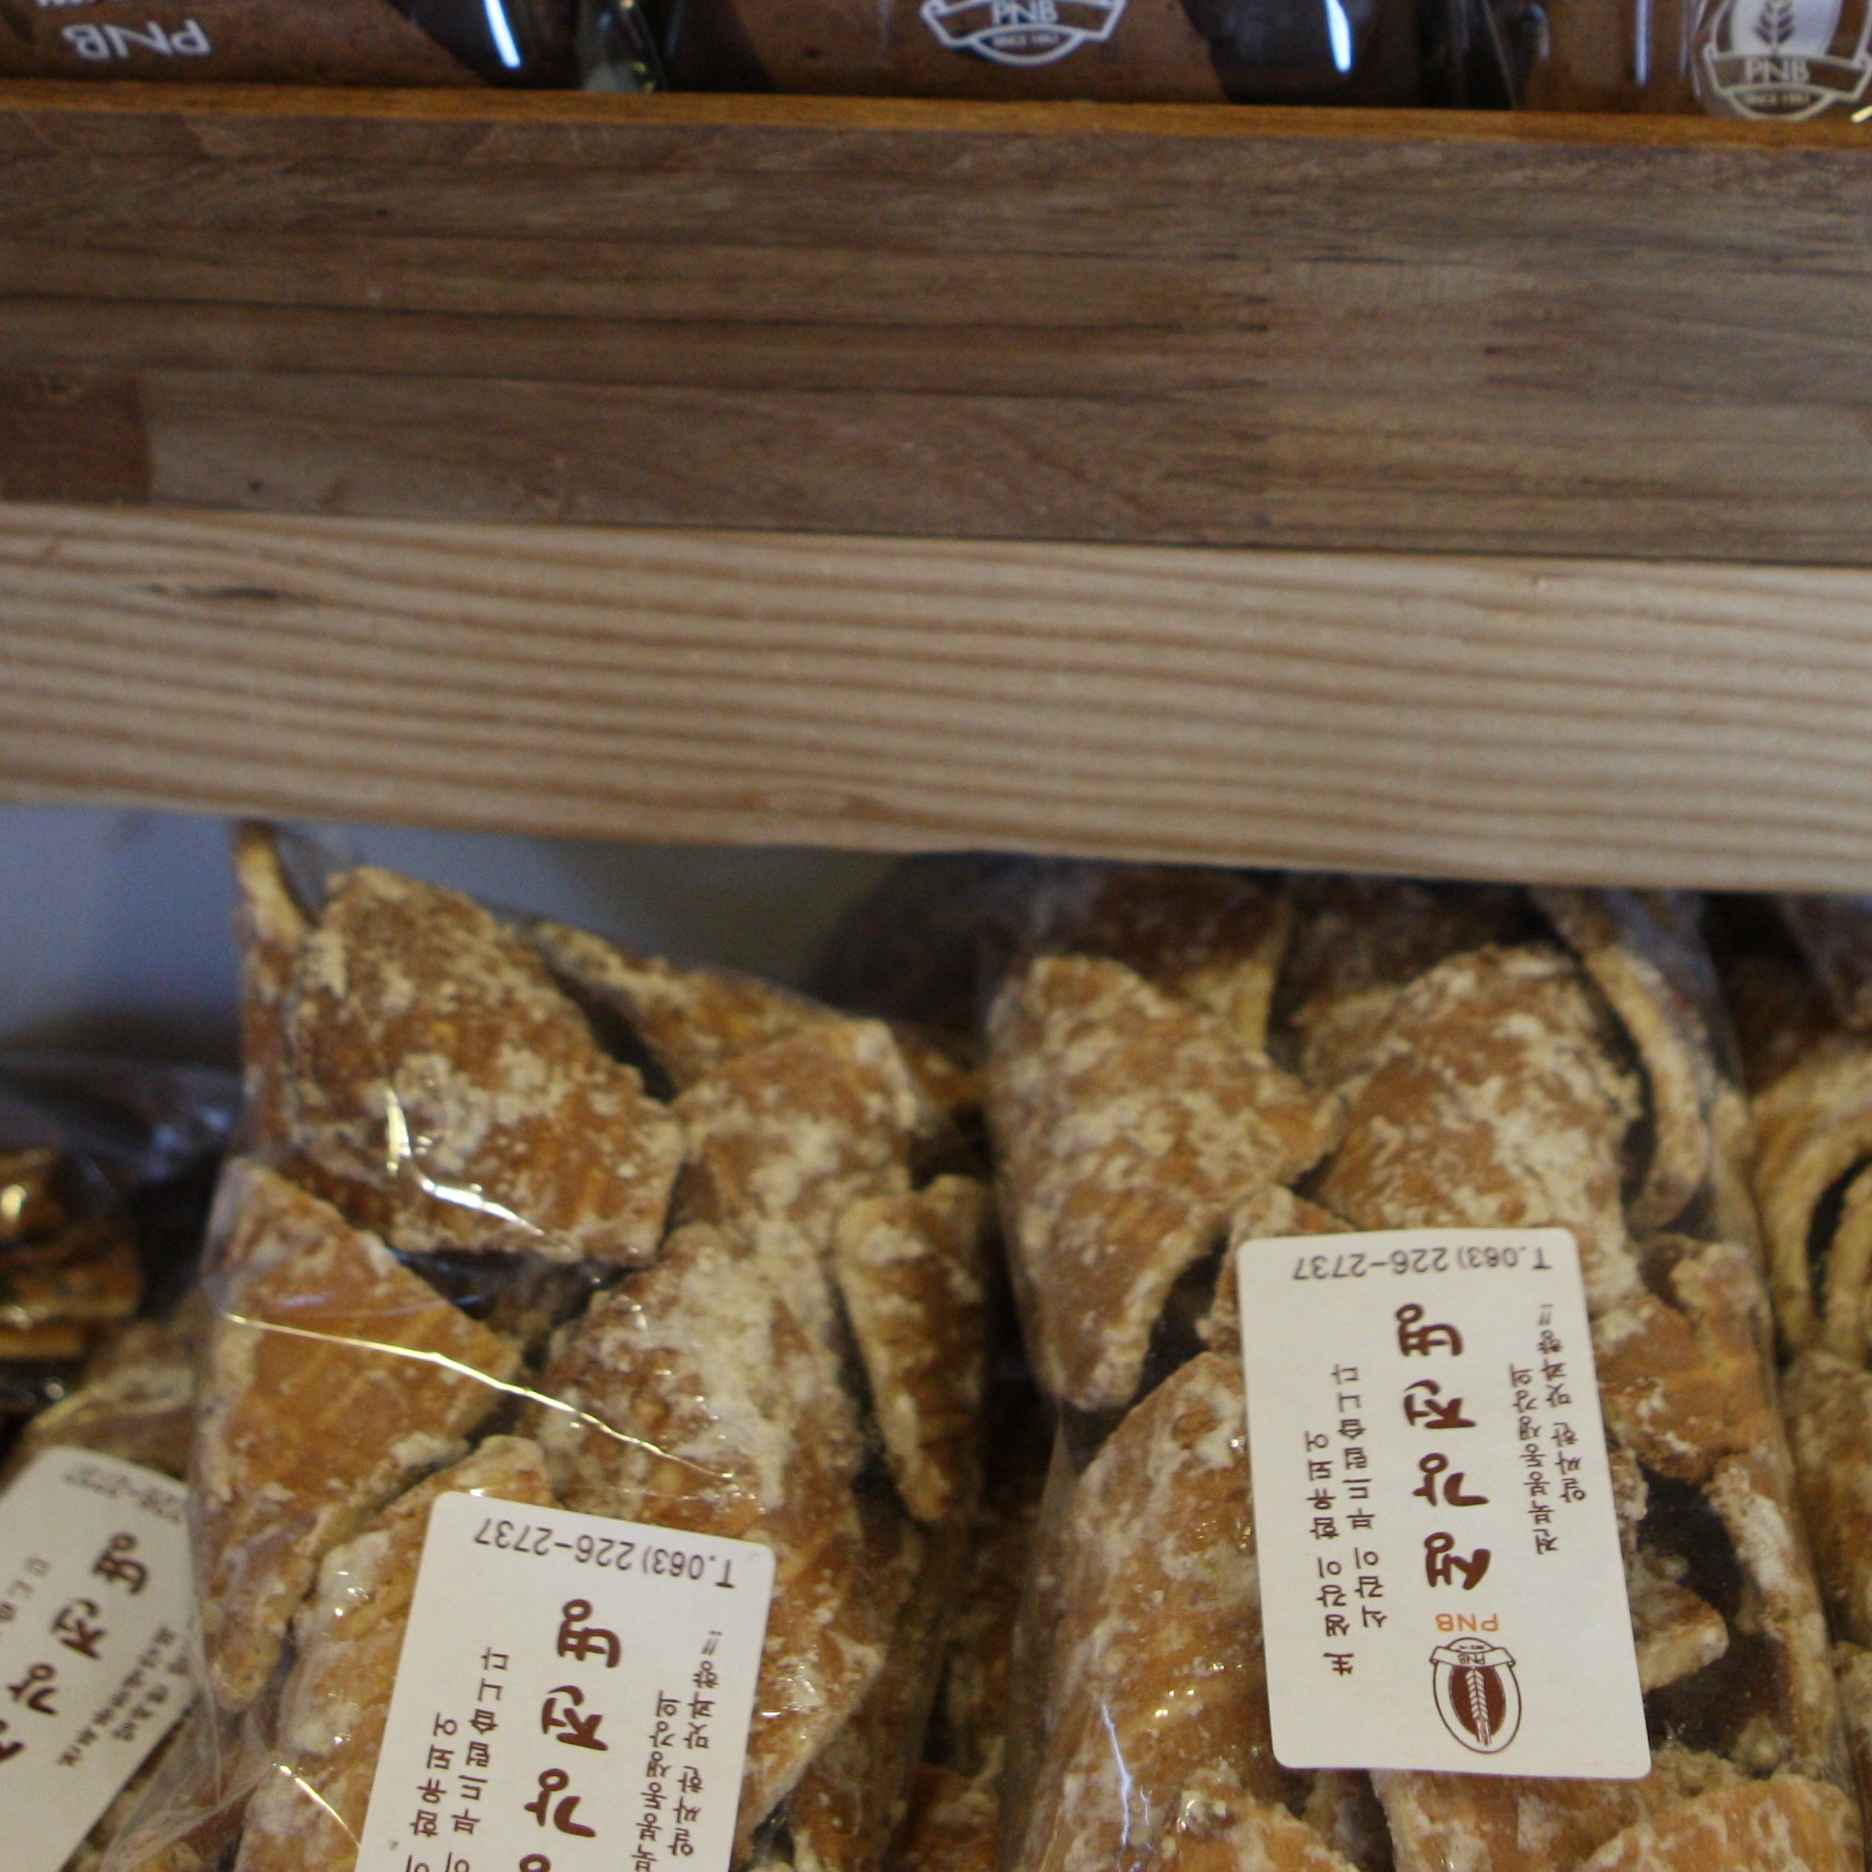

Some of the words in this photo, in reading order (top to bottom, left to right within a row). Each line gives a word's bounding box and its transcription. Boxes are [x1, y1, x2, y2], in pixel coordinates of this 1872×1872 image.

[62, 18, 210, 60] PNB
[1744, 58, 1809, 83] PNB
[1292, 1246, 1448, 1280] 226-2737
[1332, 1364, 1375, 1529] 부드럽습니다
[1395, 1303, 1491, 1591] 생강전병
[1305, 1430, 1339, 1539] 함유되어
[474, 1517, 634, 1570] 226-2737
[643, 1545, 736, 1588] T.063)
[1316, 1557, 1350, 1636] 생강이
[1434, 1612, 1499, 1632] PNB
[1323, 1653, 1355, 1675] 生
[452, 1647, 511, 1834] 부드럽습니다
[410, 1711, 458, 1837] 함유되어
[669, 1765, 707, 1857] 알싸한
